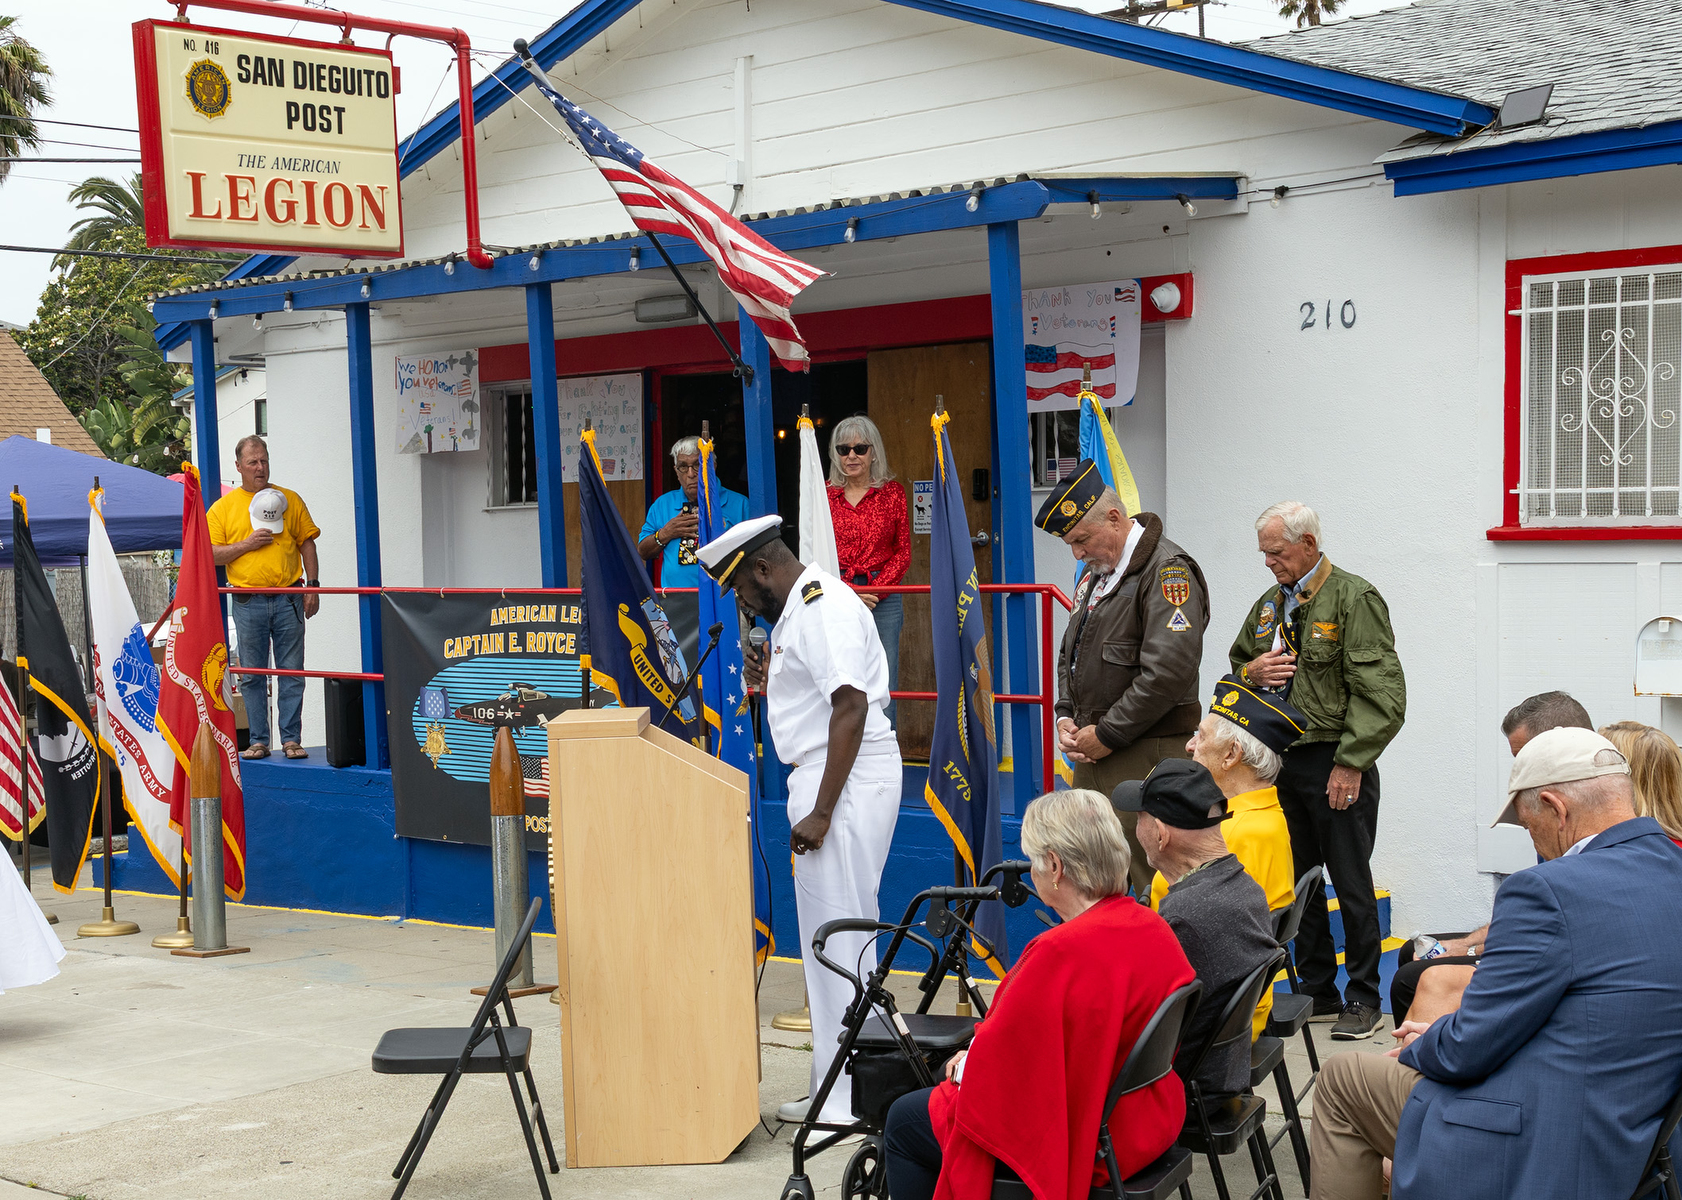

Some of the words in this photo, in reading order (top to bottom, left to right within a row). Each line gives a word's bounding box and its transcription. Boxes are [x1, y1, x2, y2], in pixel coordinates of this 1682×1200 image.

[183, 38, 198, 51] NO.
[205, 40, 219, 55] 416
[236, 54, 285, 87] SAN
[293, 60, 390, 98] DIEGUITO
[286, 101, 345, 134] POST
[237, 154, 266, 169] THE
[271, 158, 341, 174] AMERICAN
[186, 171, 388, 230] LEGION
[1300, 299, 1356, 331] 210
[914, 484, 924, 492] NO
[490, 605, 557, 626] AMERICAN
[166, 631, 180, 680] UNITED
[444, 632, 505, 658] CAPTAIN
[508, 632, 522, 652] E.
[526, 632, 576, 654] ROYCE
[633, 653, 665, 693] UNITED
[473, 707, 495, 719] 106
[1239, 716, 1250, 727] CA
[139, 763, 167, 798] ARMY
[942, 760, 972, 802] 1775
